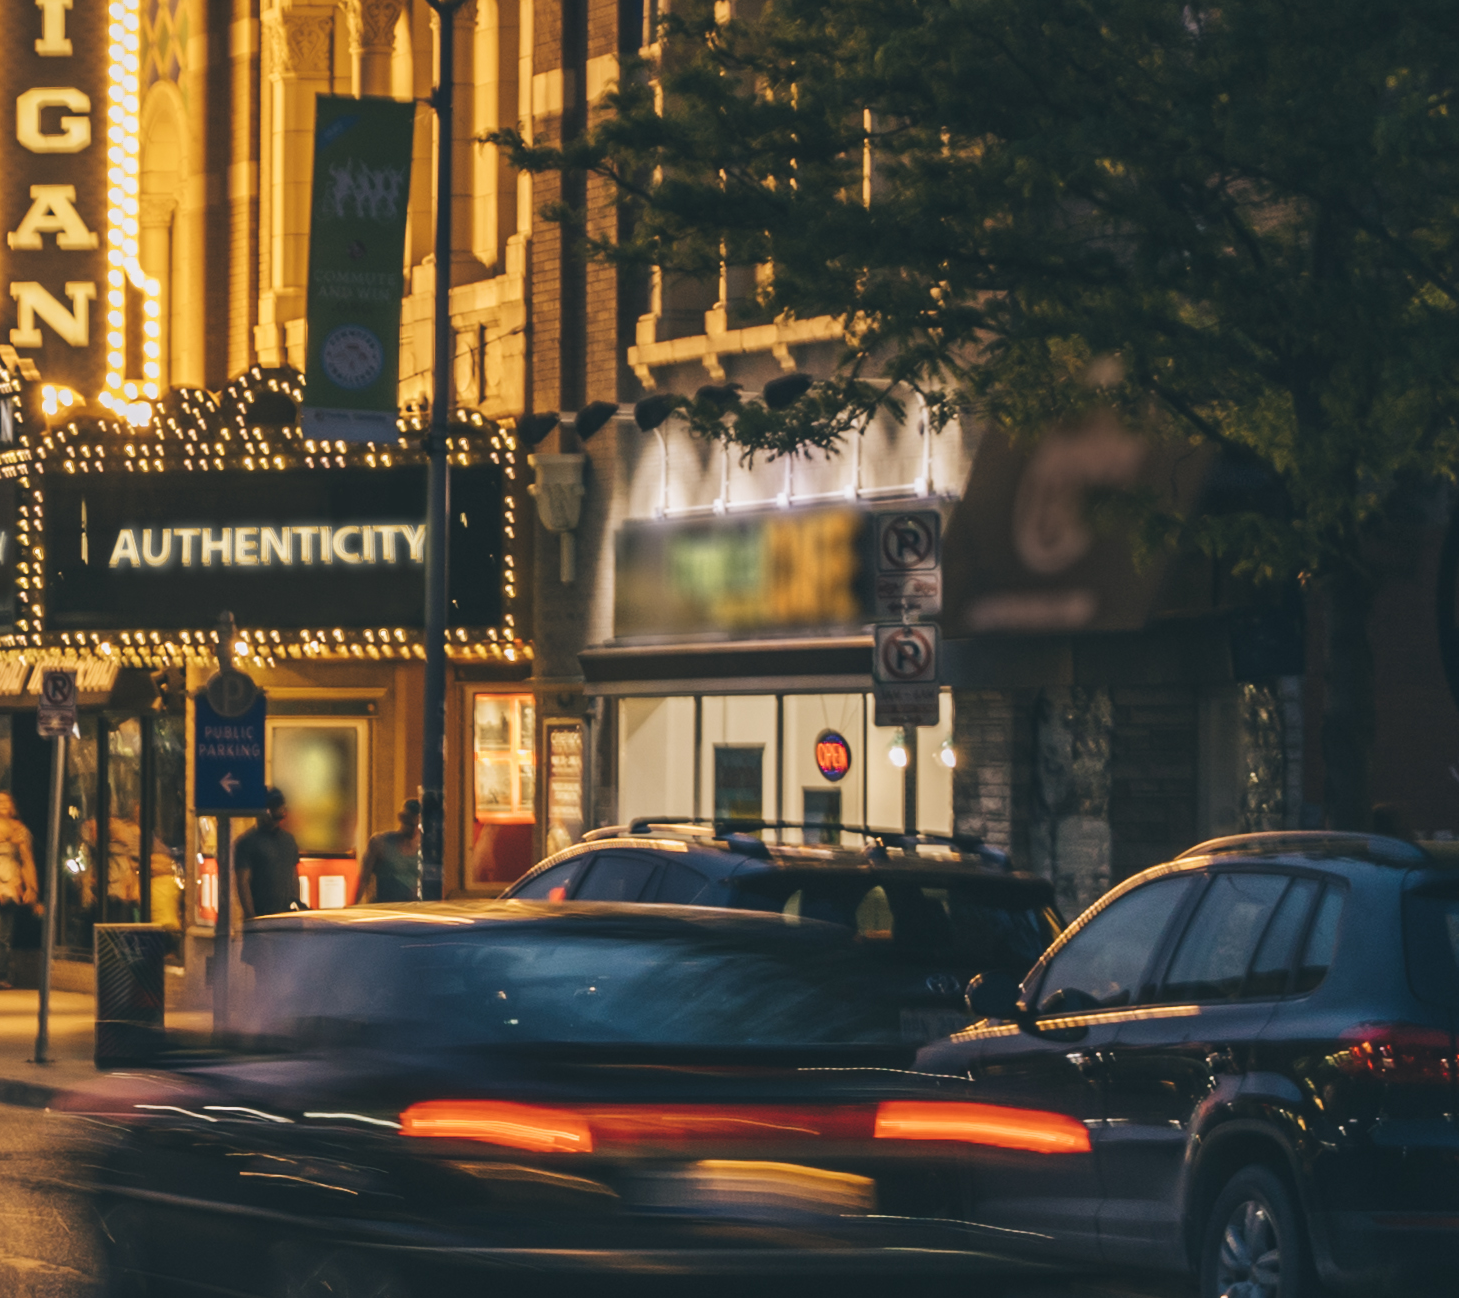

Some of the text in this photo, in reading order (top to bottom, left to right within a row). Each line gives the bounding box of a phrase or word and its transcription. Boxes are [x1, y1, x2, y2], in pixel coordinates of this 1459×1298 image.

[108, 523, 427, 568] AUTHENTICITY
[204, 725, 254, 740] PUBLIC
[199, 743, 261, 757] PARKING
[816, 742, 848, 770] OPEN
